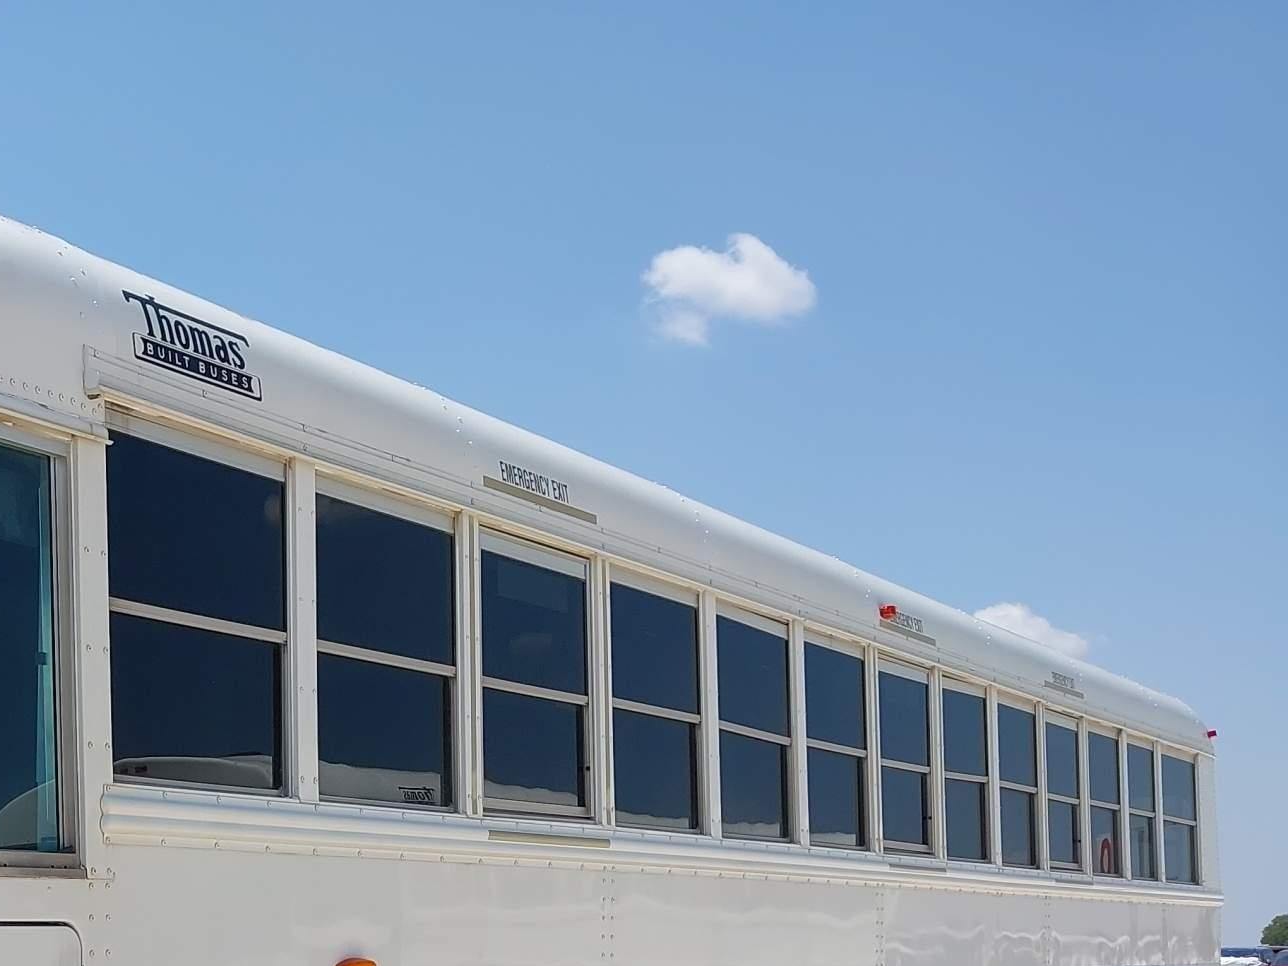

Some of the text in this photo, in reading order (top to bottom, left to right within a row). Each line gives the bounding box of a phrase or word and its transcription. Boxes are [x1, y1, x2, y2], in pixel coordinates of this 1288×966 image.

[122, 290, 250, 370] Thomas
[146, 342, 249, 389] BUILT BUSES
[499, 460, 570, 504] EMERGENCY EXIT
